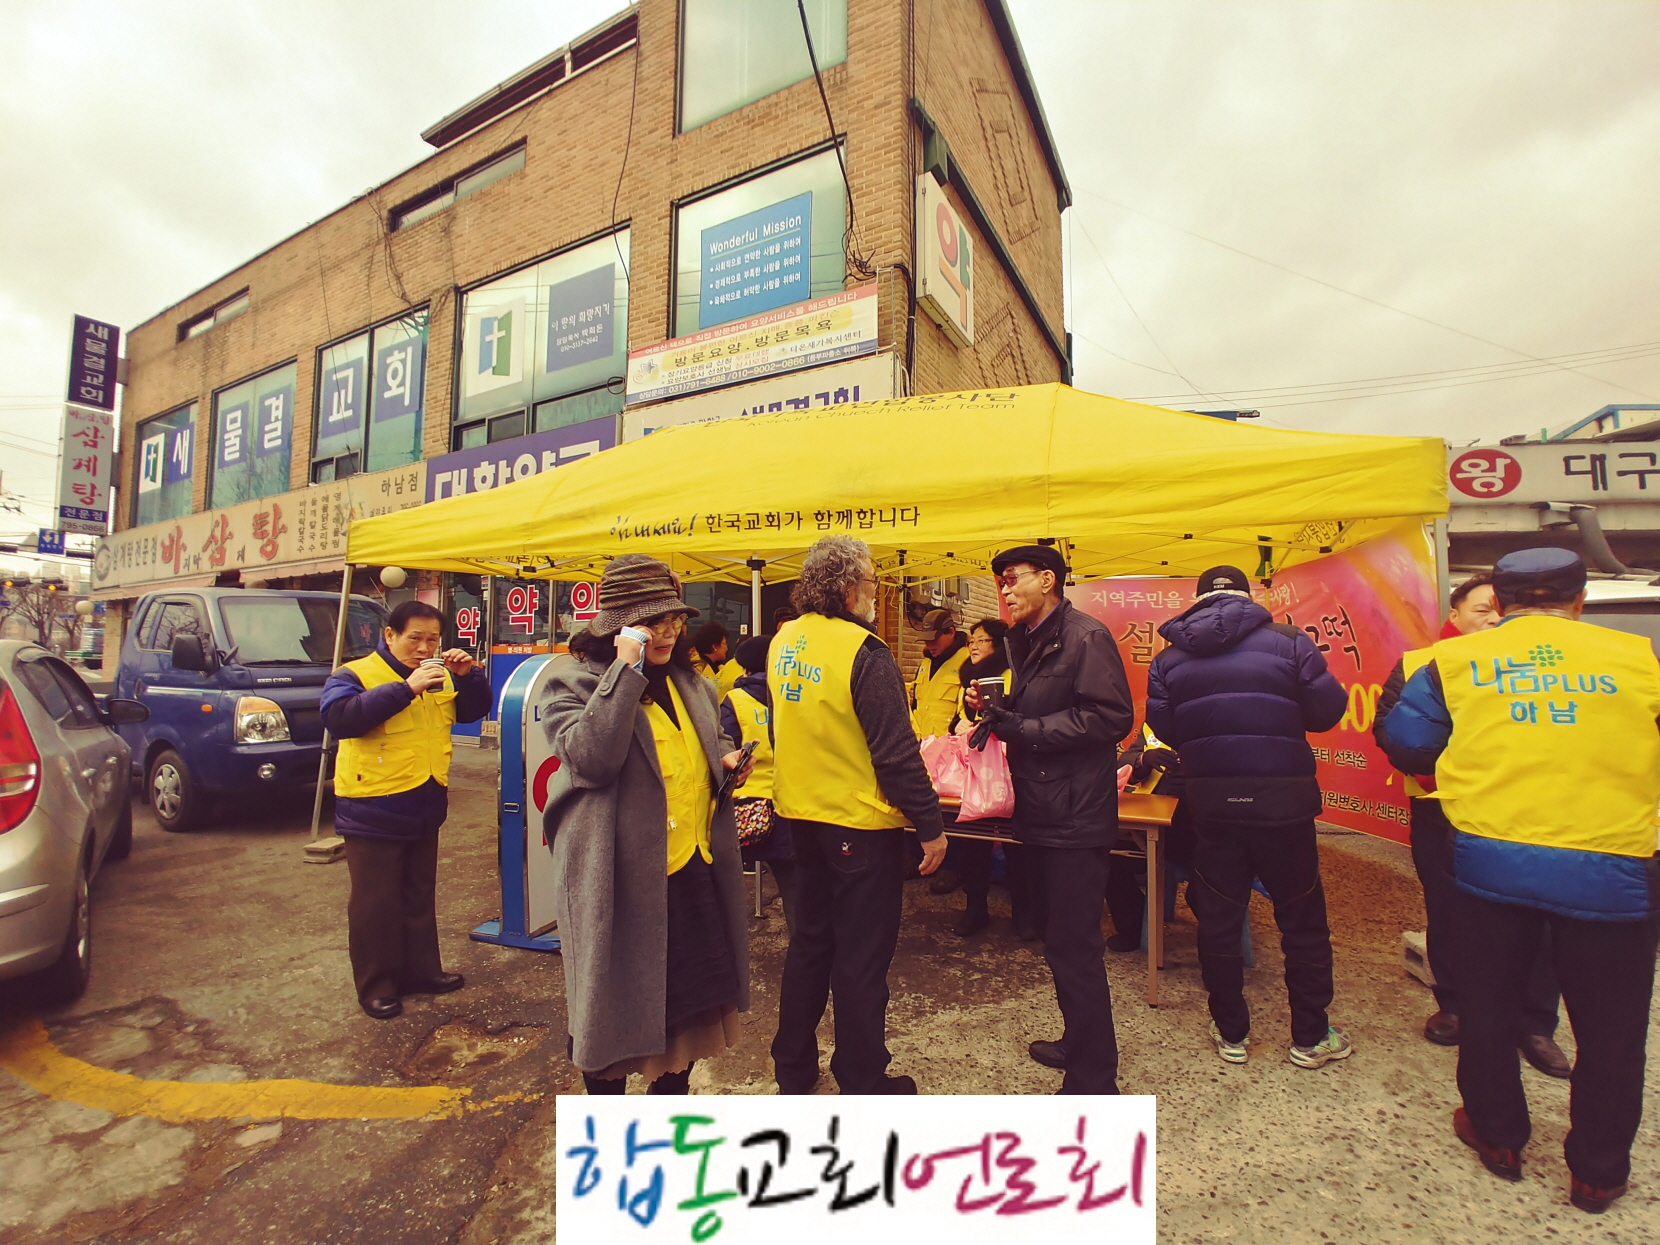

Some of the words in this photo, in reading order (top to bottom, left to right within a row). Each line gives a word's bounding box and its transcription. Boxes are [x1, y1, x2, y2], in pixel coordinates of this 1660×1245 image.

[709, 227, 758, 255] Wonderful
[763, 215, 802, 237] Mission
[763, 243, 781, 256] 사람을
[784, 236, 801, 250] 위하여
[714, 273, 741, 290] 경제적으로
[744, 266, 761, 280] 부족한
[763, 260, 781, 274] 사람을
[783, 253, 801, 268] 위하여
[763, 277, 780, 292] 사람을
[783, 271, 801, 286] 위하여
[936, 202, 970, 332] 약
[551, 320, 559, 332] 이
[578, 302, 610, 323] 희망지기
[645, 343, 668, 355] 어르신
[714, 322, 748, 337] 방문하여
[751, 307, 804, 327] 요양서비스를
[808, 292, 858, 312] 해드립니다
[381, 471, 419, 497] 하남점
[1456, 458, 1511, 493] 왕
[704, 511, 804, 534] 한국교회가
[812, 506, 921, 531] 함께합니다
[507, 585, 539, 635] 약
[1091, 590, 1184, 609] 지역주민을
[457, 607, 480, 647] 약
[1470, 657, 1618, 694] 나눔PLUS
[1510, 700, 1578, 724] 하남
[1334, 750, 1367, 770] 선착순
